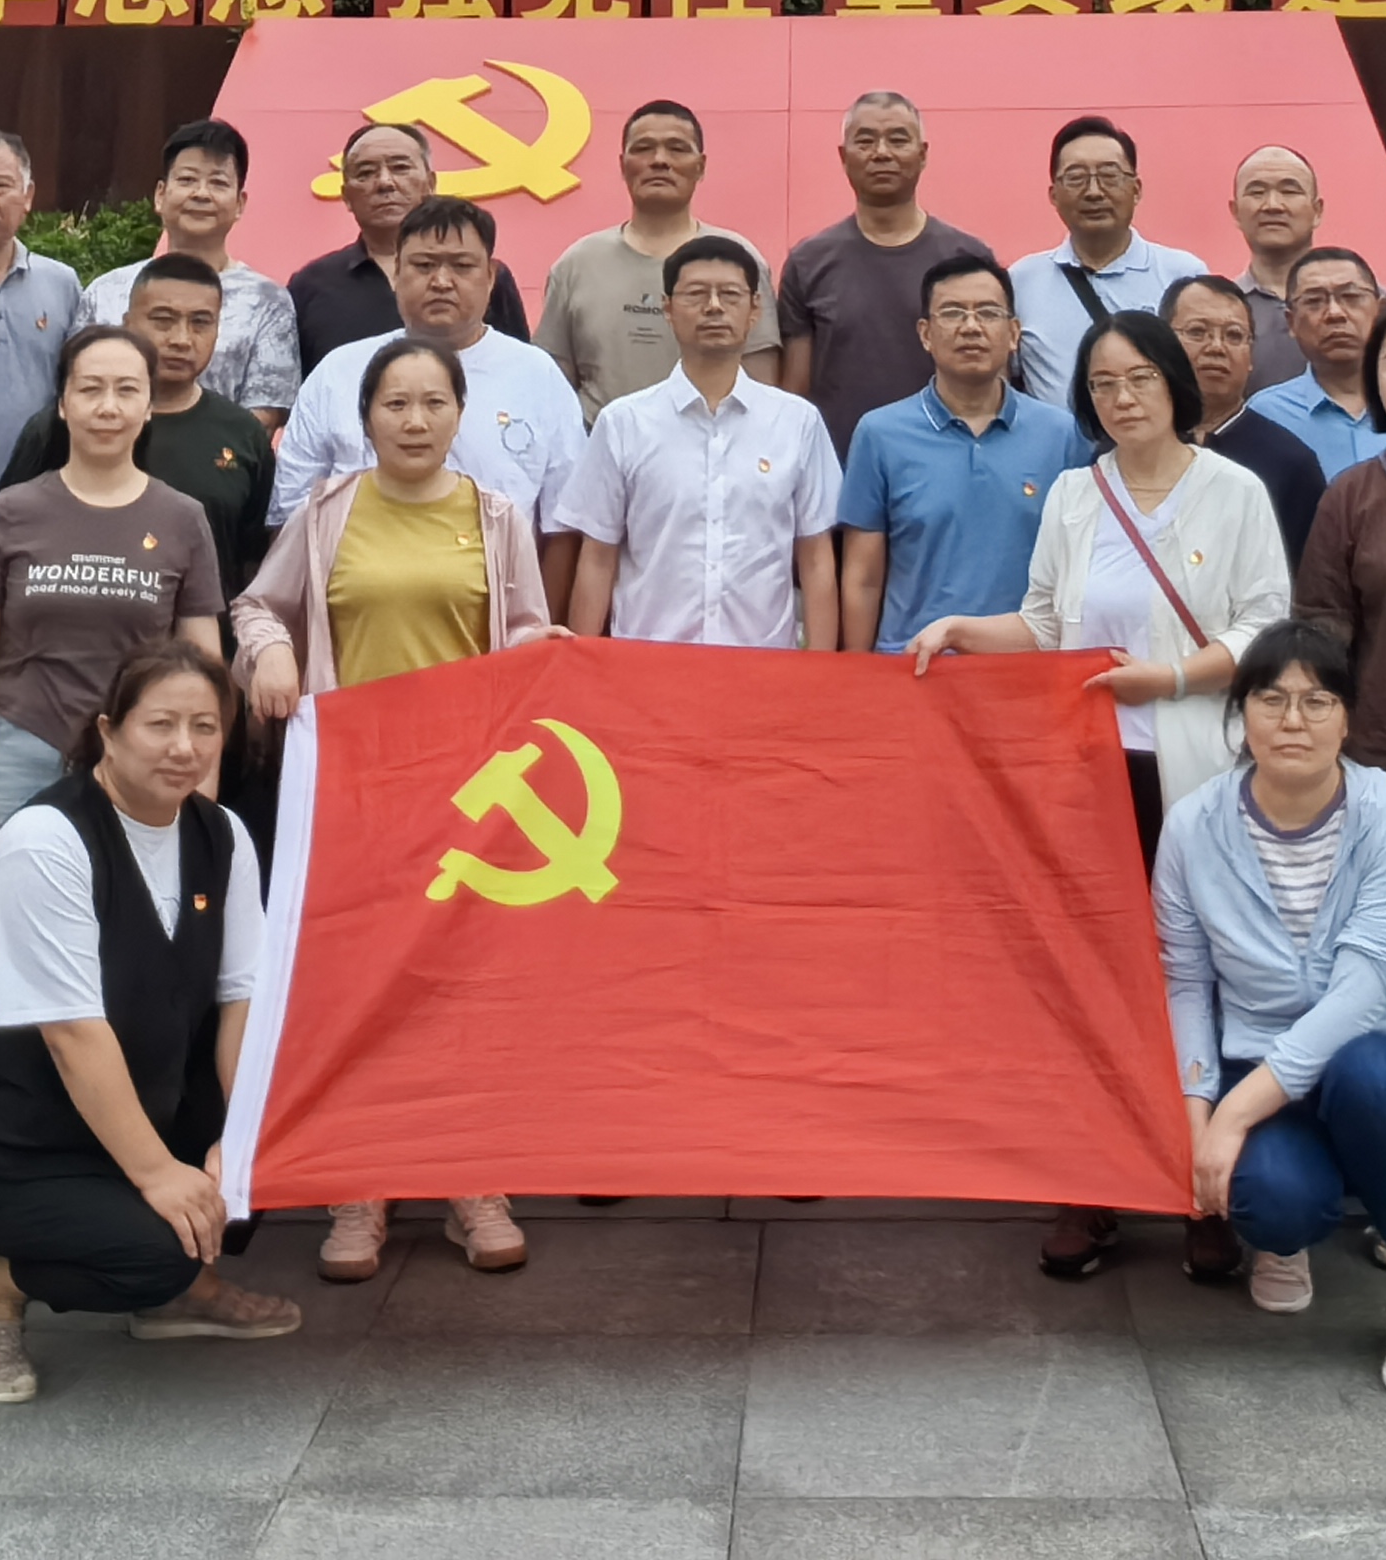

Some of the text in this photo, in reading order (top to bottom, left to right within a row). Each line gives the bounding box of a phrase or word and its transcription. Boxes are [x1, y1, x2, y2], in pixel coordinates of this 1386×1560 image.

[28, 564, 162, 590] WONDERFUL
[25, 583, 58, 596] good
[60, 584, 98, 595] mood
[101, 587, 136, 600] every
